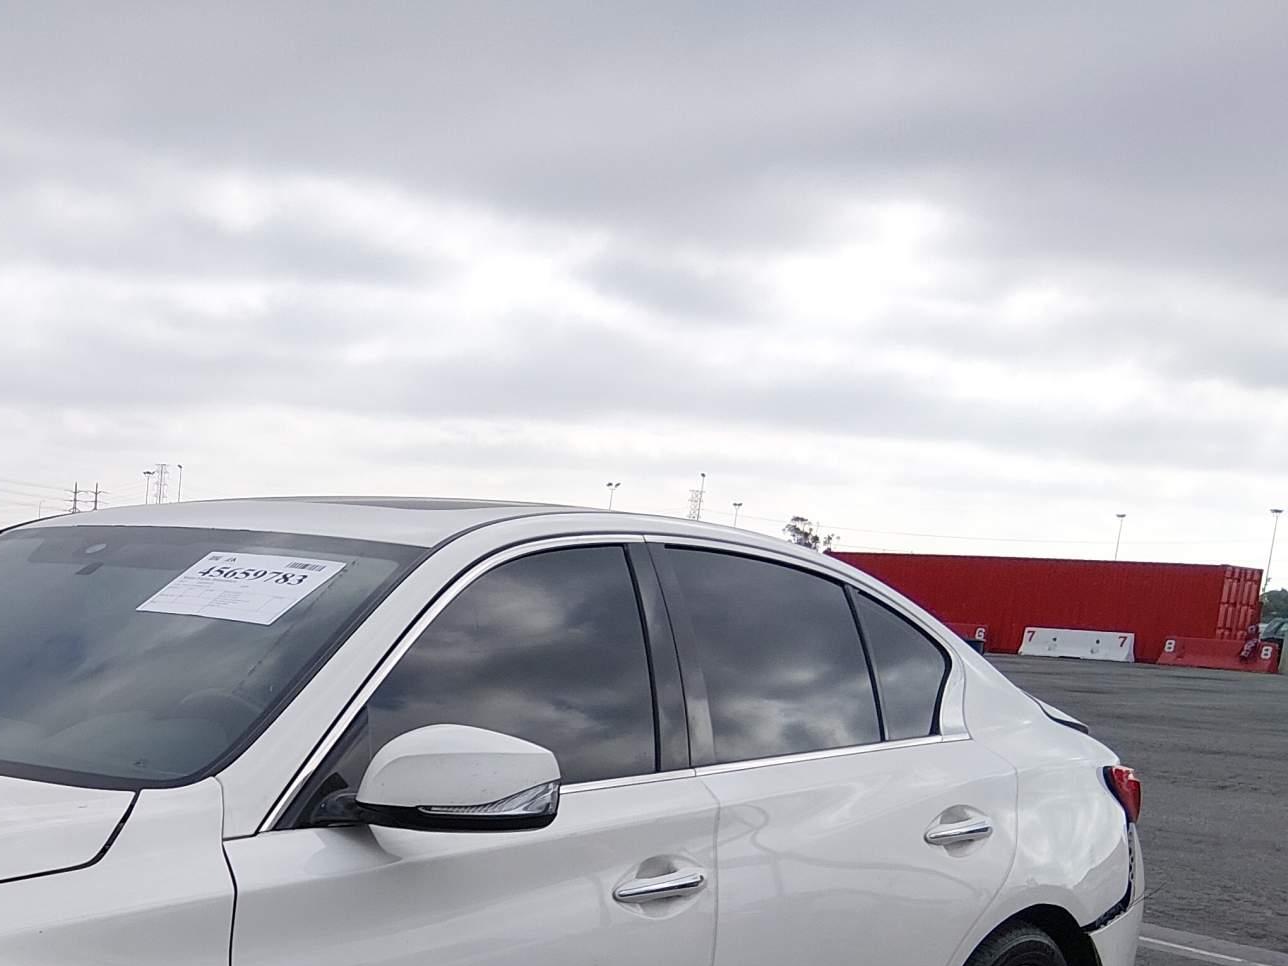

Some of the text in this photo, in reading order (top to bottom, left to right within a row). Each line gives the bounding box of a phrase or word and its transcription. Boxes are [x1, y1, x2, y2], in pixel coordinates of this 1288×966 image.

[198, 565, 309, 586] 45659783
[1026, 630, 1036, 643] 7
[1118, 636, 1128, 648] 7
[1164, 639, 1176, 653] 8
[1260, 646, 1272, 659] 8
